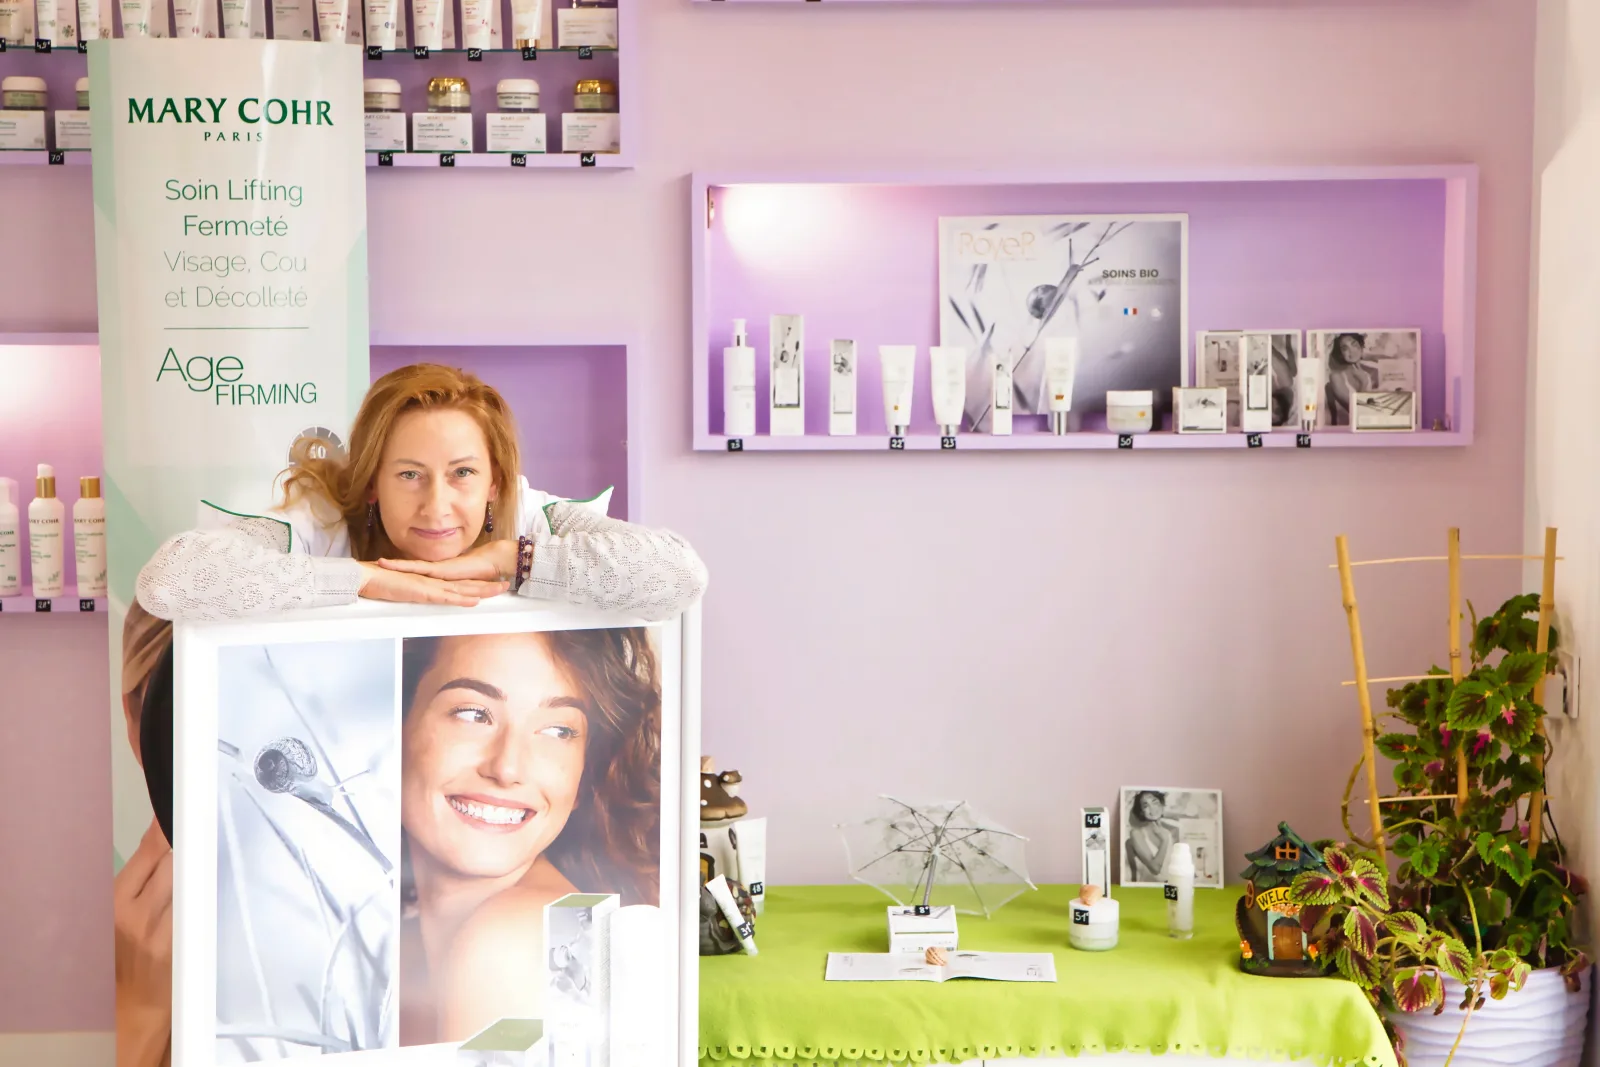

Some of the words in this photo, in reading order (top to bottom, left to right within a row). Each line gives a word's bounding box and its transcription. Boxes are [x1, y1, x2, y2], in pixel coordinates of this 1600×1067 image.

[127, 98, 228, 124] MARY
[238, 98, 334, 126] COHR
[204, 132, 263, 142] PARIS
[165, 179, 218, 202] Soin
[228, 179, 303, 207] Lifting
[184, 215, 289, 237] Fermeté
[163, 250, 252, 278] Visage,
[260, 250, 307, 273] Cou
[1102, 269, 1136, 278] SOINS
[1139, 269, 1159, 278] BIO
[165, 289, 188, 308] et
[196, 285, 308, 308] Décolleté
[156, 347, 244, 392] Age
[216, 382, 318, 406] FIRMING
[1258, 889, 1289, 908] WELC
